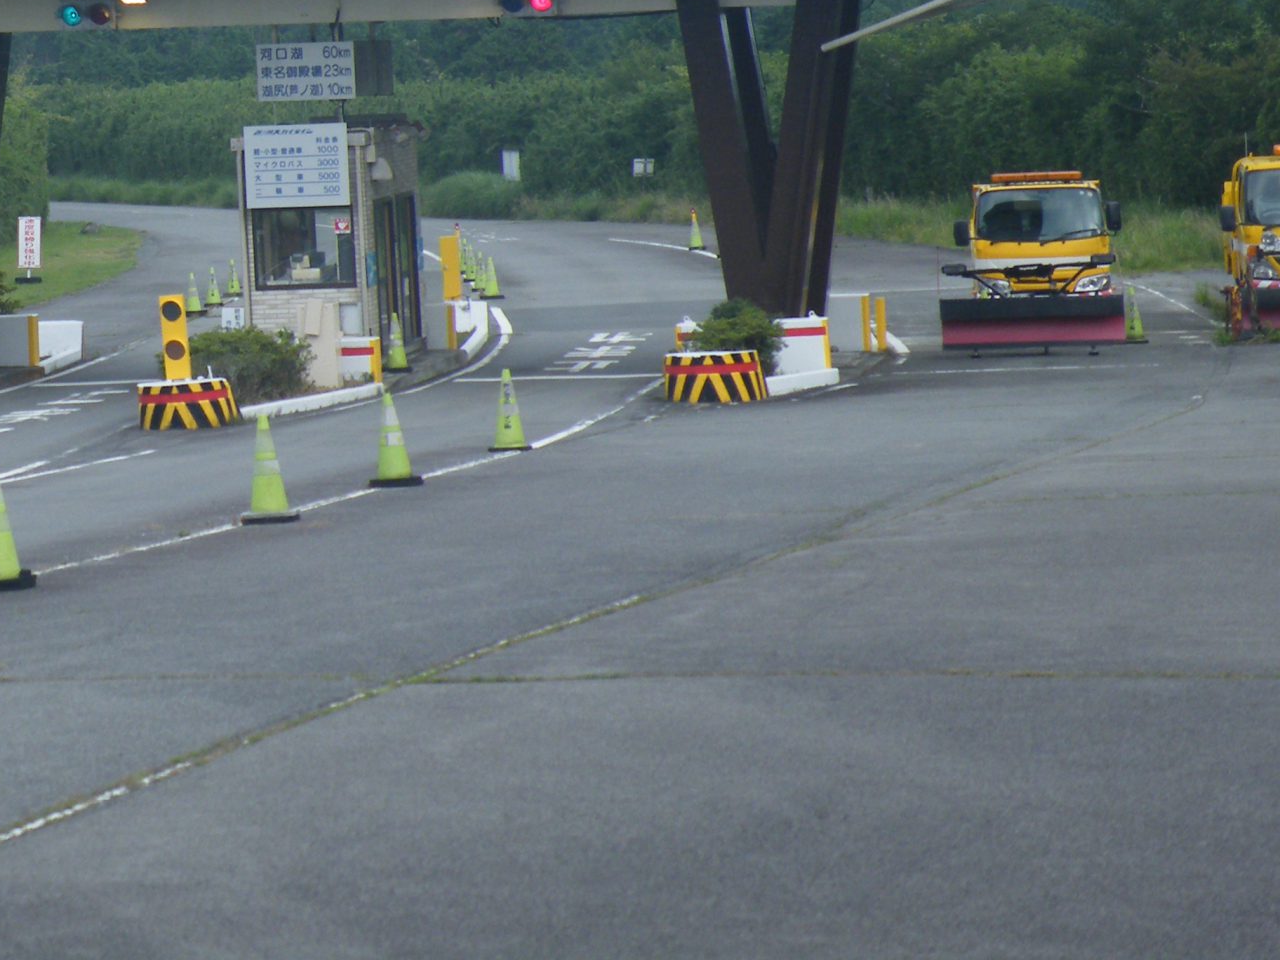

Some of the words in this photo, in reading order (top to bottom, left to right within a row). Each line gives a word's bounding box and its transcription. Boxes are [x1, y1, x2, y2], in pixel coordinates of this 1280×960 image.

[260, 46, 303, 61] 河口湖
[322, 45, 351, 58] 60km
[261, 65, 322, 79] 東名御殿場
[323, 64, 352, 77] 23km
[327, 82, 353, 96] 10km
[316, 145, 340, 154] 1000
[254, 160, 304, 168] マイクロバス
[318, 171, 341, 180] 5000
[323, 185, 340, 193] 500
